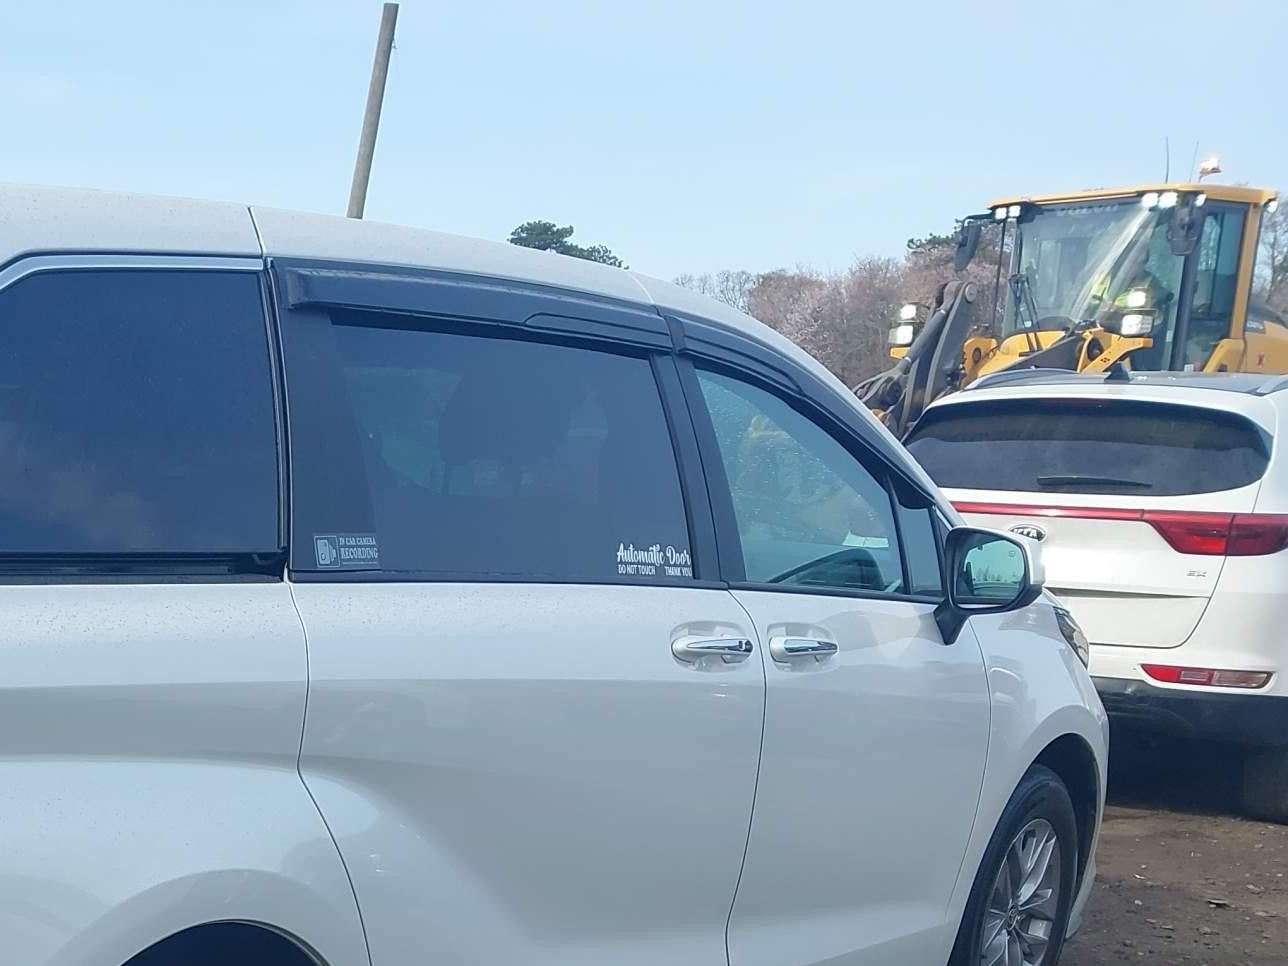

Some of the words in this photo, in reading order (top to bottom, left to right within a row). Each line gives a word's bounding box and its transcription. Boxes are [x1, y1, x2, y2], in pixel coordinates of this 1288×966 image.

[340, 547, 379, 559] RECORDING
[617, 543, 665, 567] Automatic
[666, 545, 691, 566] Door
[618, 564, 626, 574] DO
[626, 564, 638, 575] NOT
[638, 564, 656, 576] TOUCH
[664, 566, 681, 577] THANK
[682, 566, 692, 577] YOU
